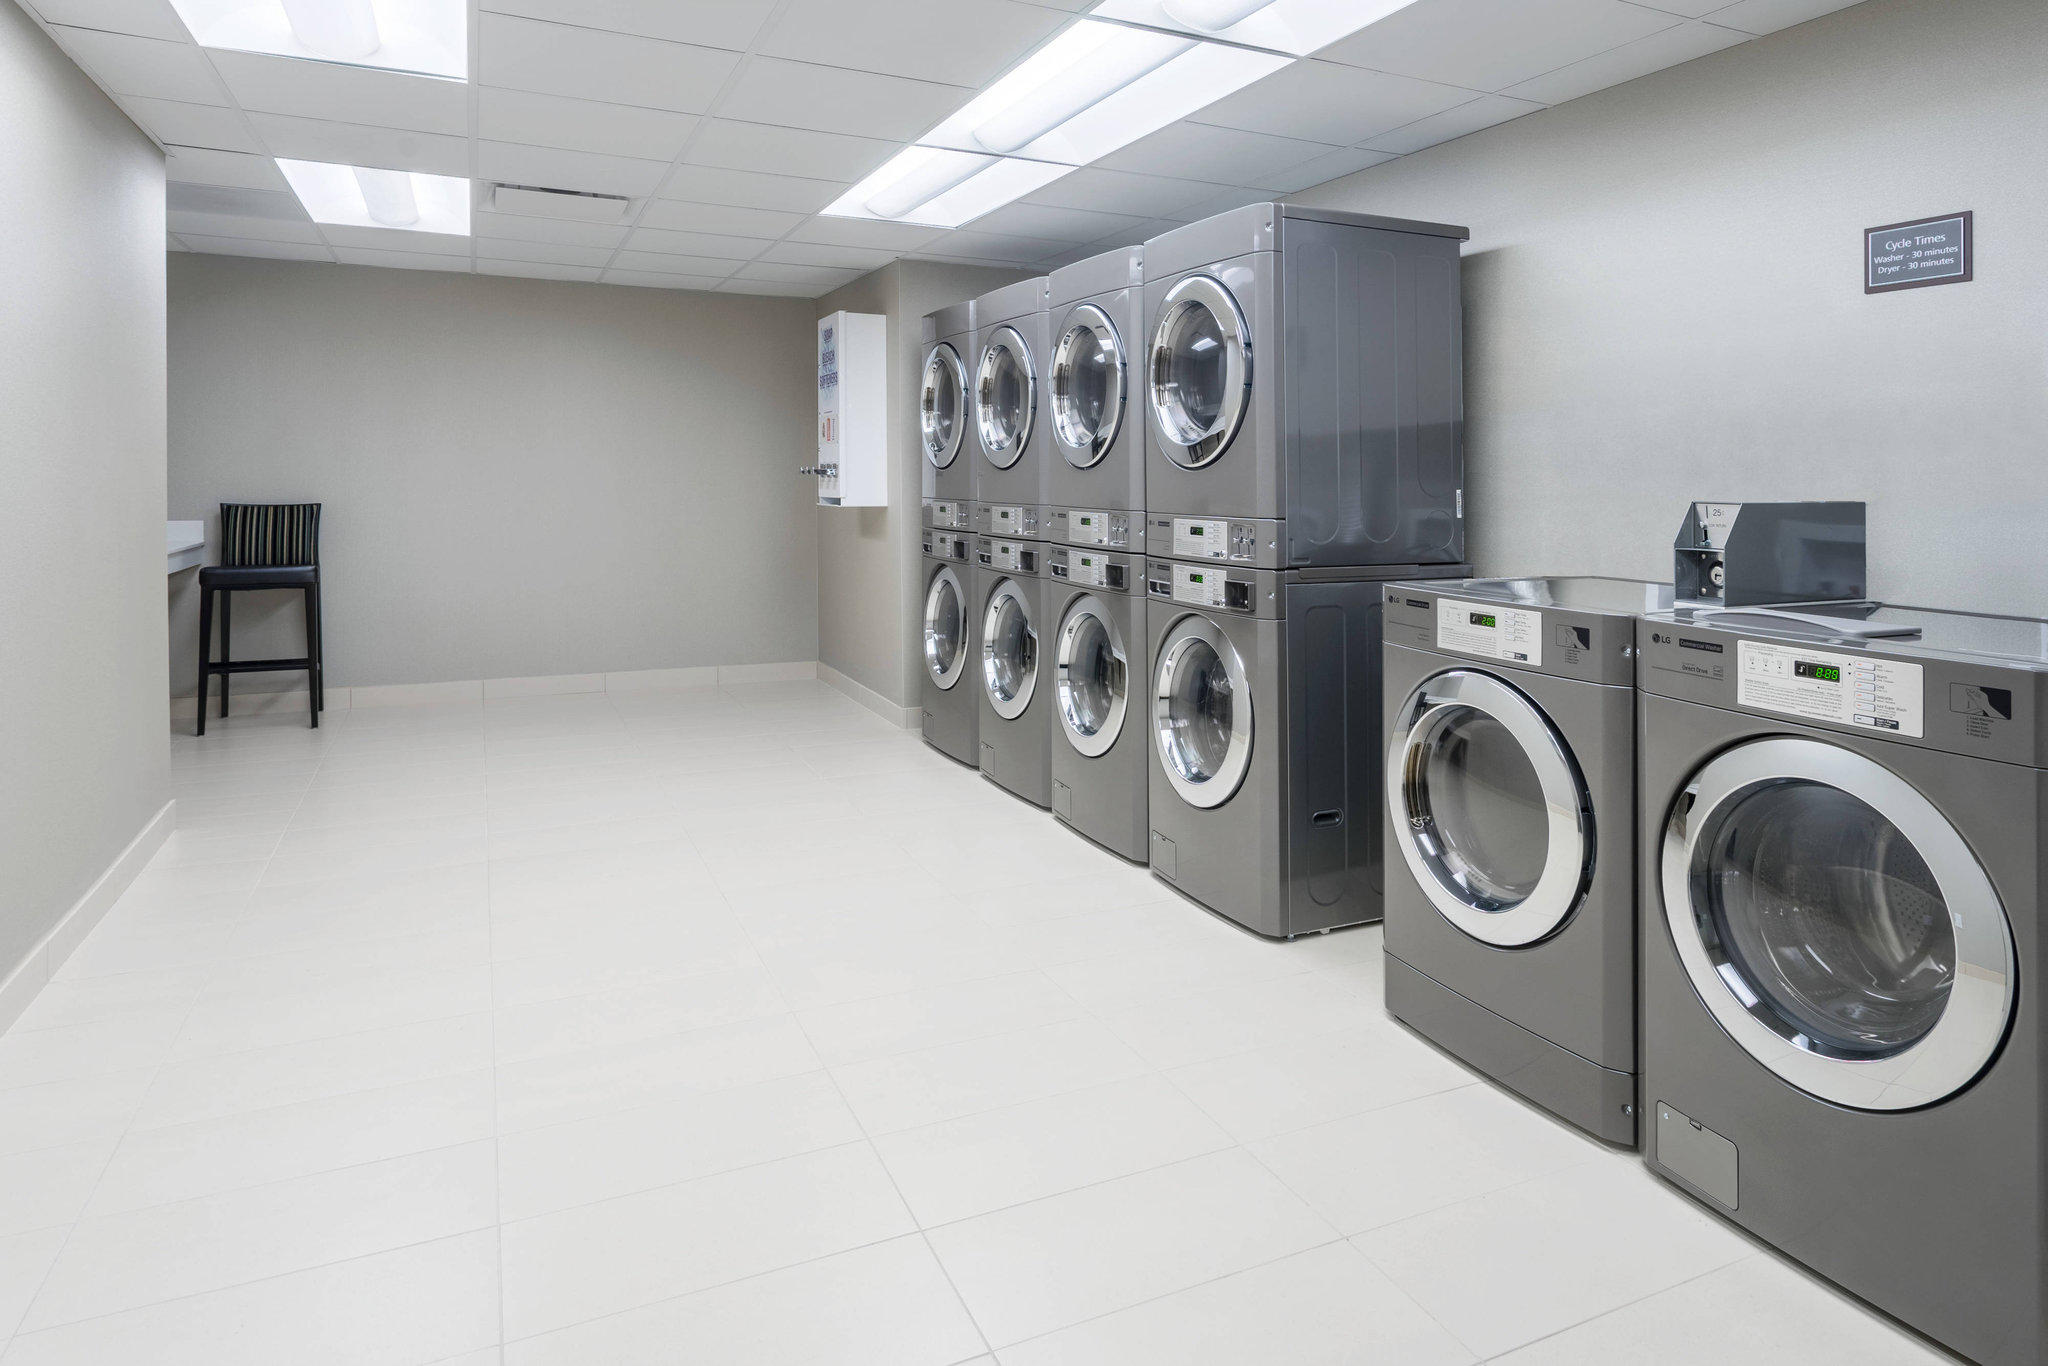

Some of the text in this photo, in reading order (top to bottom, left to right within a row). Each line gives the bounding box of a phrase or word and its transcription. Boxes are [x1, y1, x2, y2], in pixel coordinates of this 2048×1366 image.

[1885, 233, 1946, 252] Cycle Times
[1874, 253, 1904, 264] Washer
[1912, 250, 1922, 259] 30
[1924, 245, 1959, 257] minutes
[1877, 265, 1901, 275] Dryer
[1907, 261, 1919, 270] 30
[1920, 256, 1955, 268] minutes
